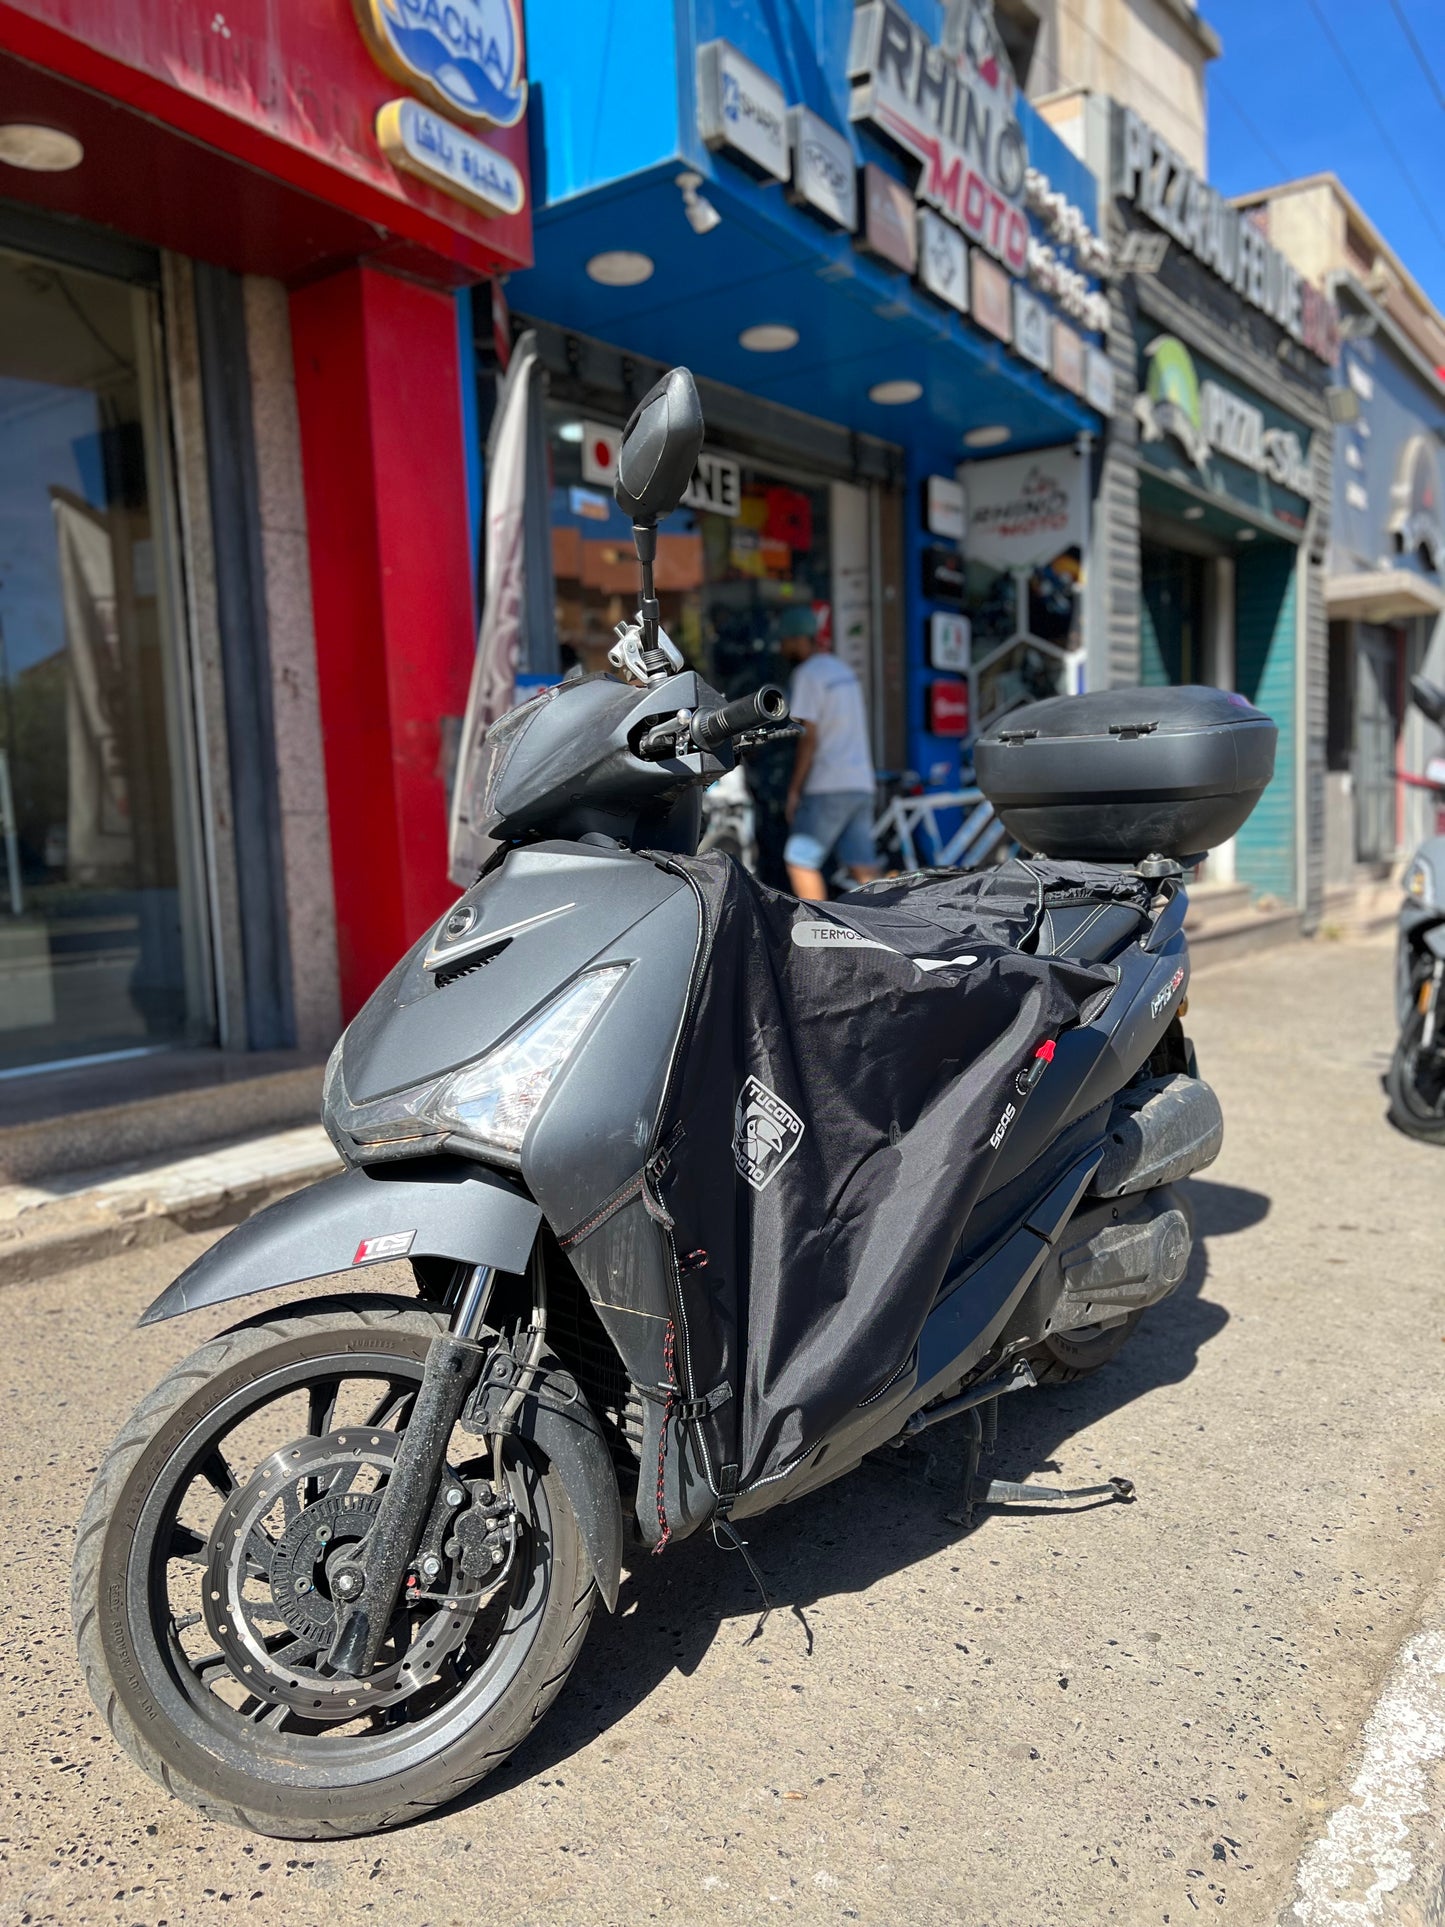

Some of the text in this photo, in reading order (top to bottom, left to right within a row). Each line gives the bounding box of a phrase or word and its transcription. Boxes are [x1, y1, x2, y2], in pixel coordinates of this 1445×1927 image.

[876, 8, 1026, 198] RHINO
[925, 135, 1028, 272] MOTO
[811, 928, 870, 941] TERMOS
